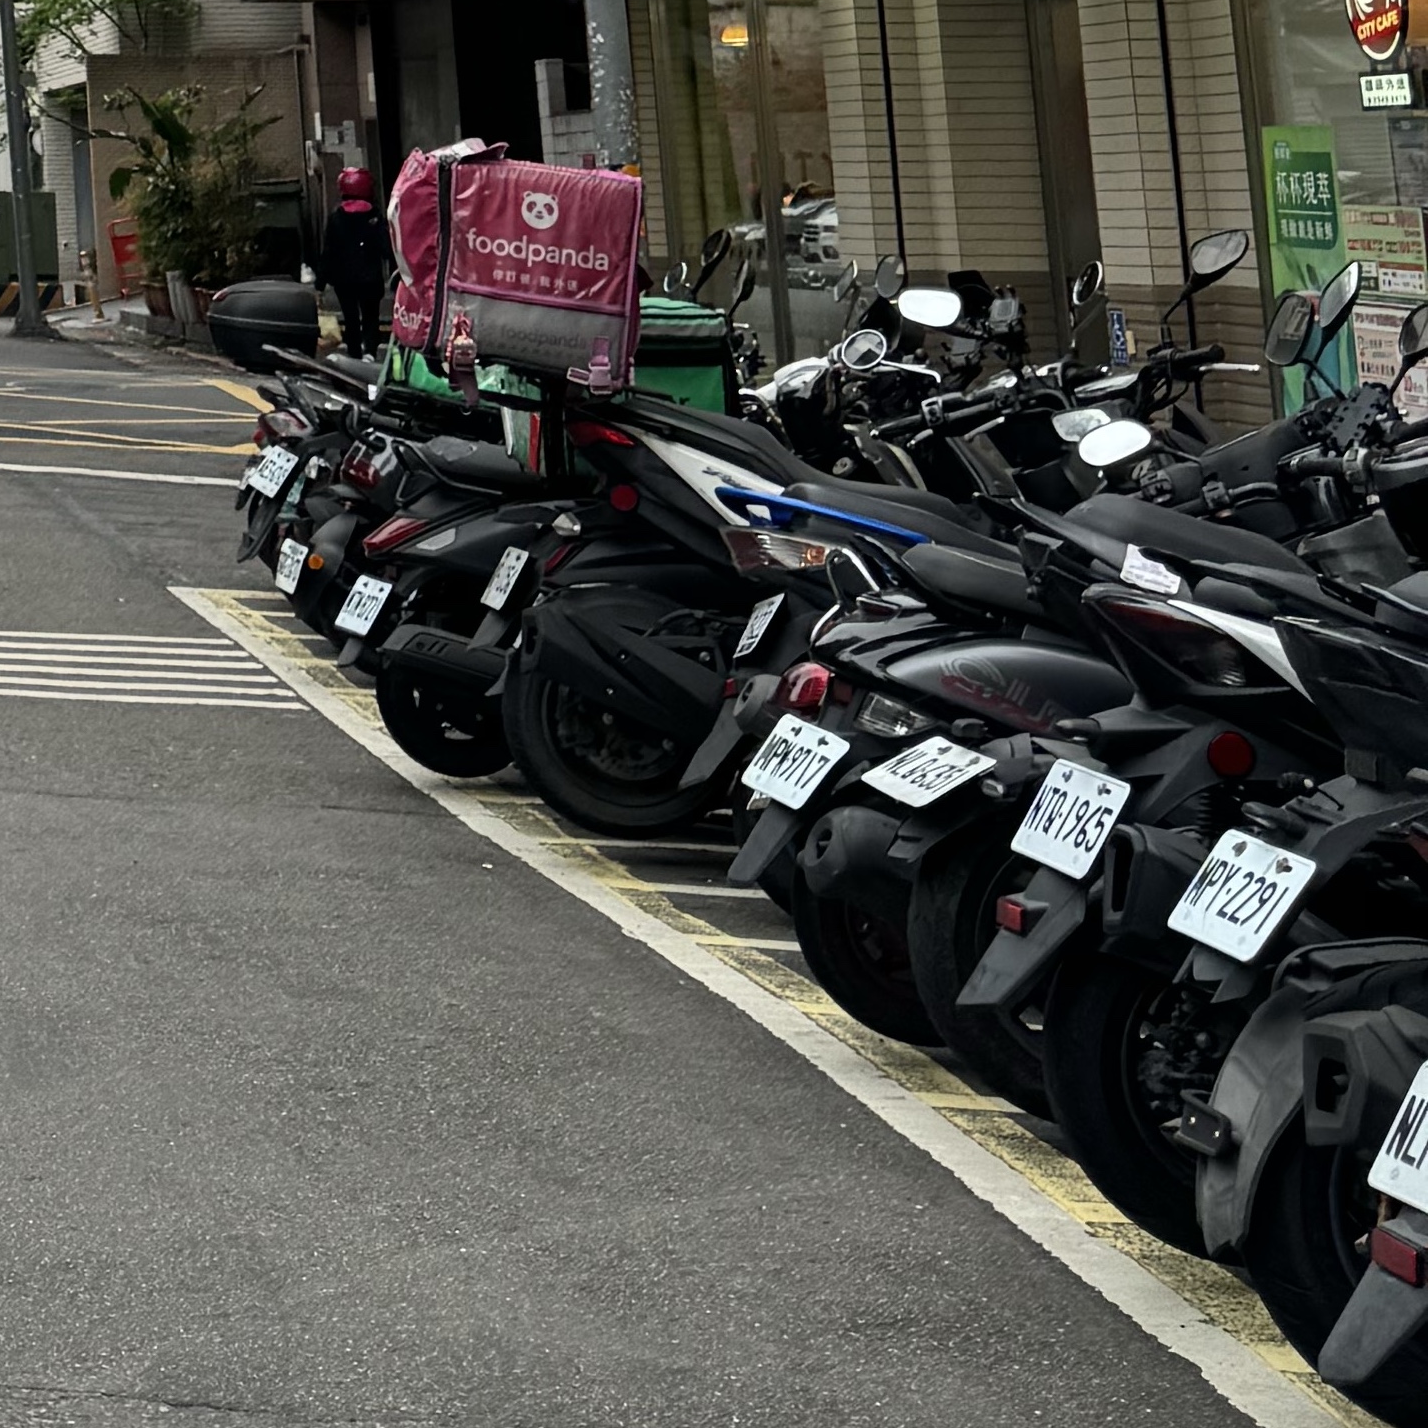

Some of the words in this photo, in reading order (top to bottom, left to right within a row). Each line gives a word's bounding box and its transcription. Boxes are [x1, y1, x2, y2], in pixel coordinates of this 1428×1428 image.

[1357, 19, 1376, 41] CITY
[1376, 9, 1399, 32] CAFE
[466, 228, 609, 271] foodpanda
[1184, 856, 1286, 933] MPY-2291
